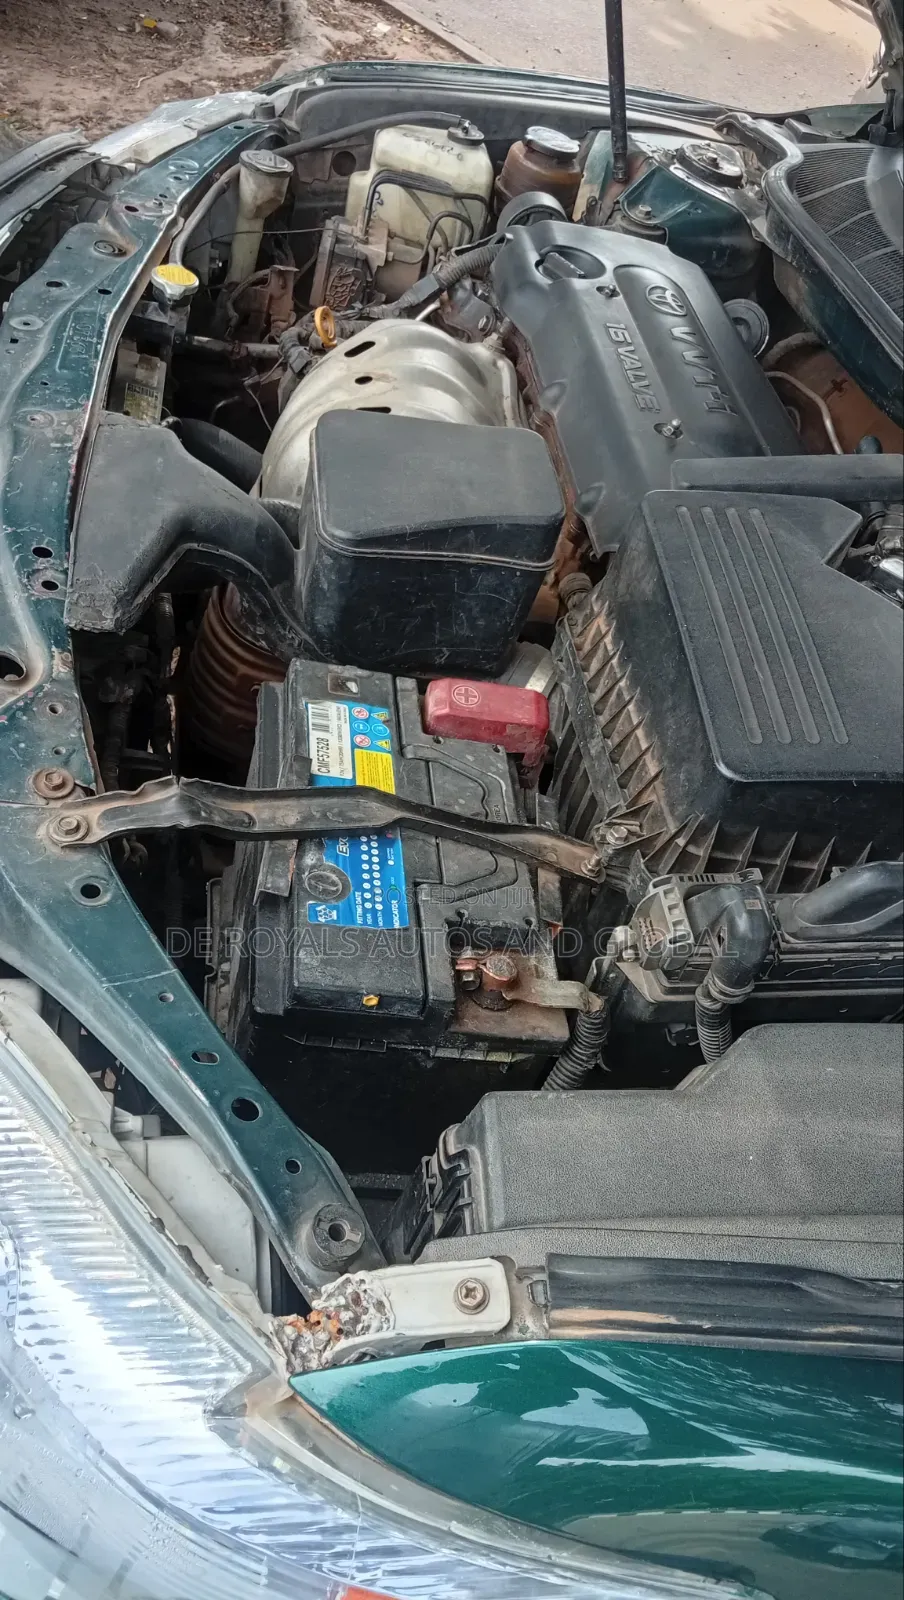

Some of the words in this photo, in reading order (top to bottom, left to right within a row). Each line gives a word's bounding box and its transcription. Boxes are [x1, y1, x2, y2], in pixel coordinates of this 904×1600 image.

[605, 322, 633, 344] 16
[616, 345, 661, 413] VALVE
[316, 737, 331, 774] CMF57528
[354, 891, 362, 904] DATE
[355, 905, 363, 925] FITTING
